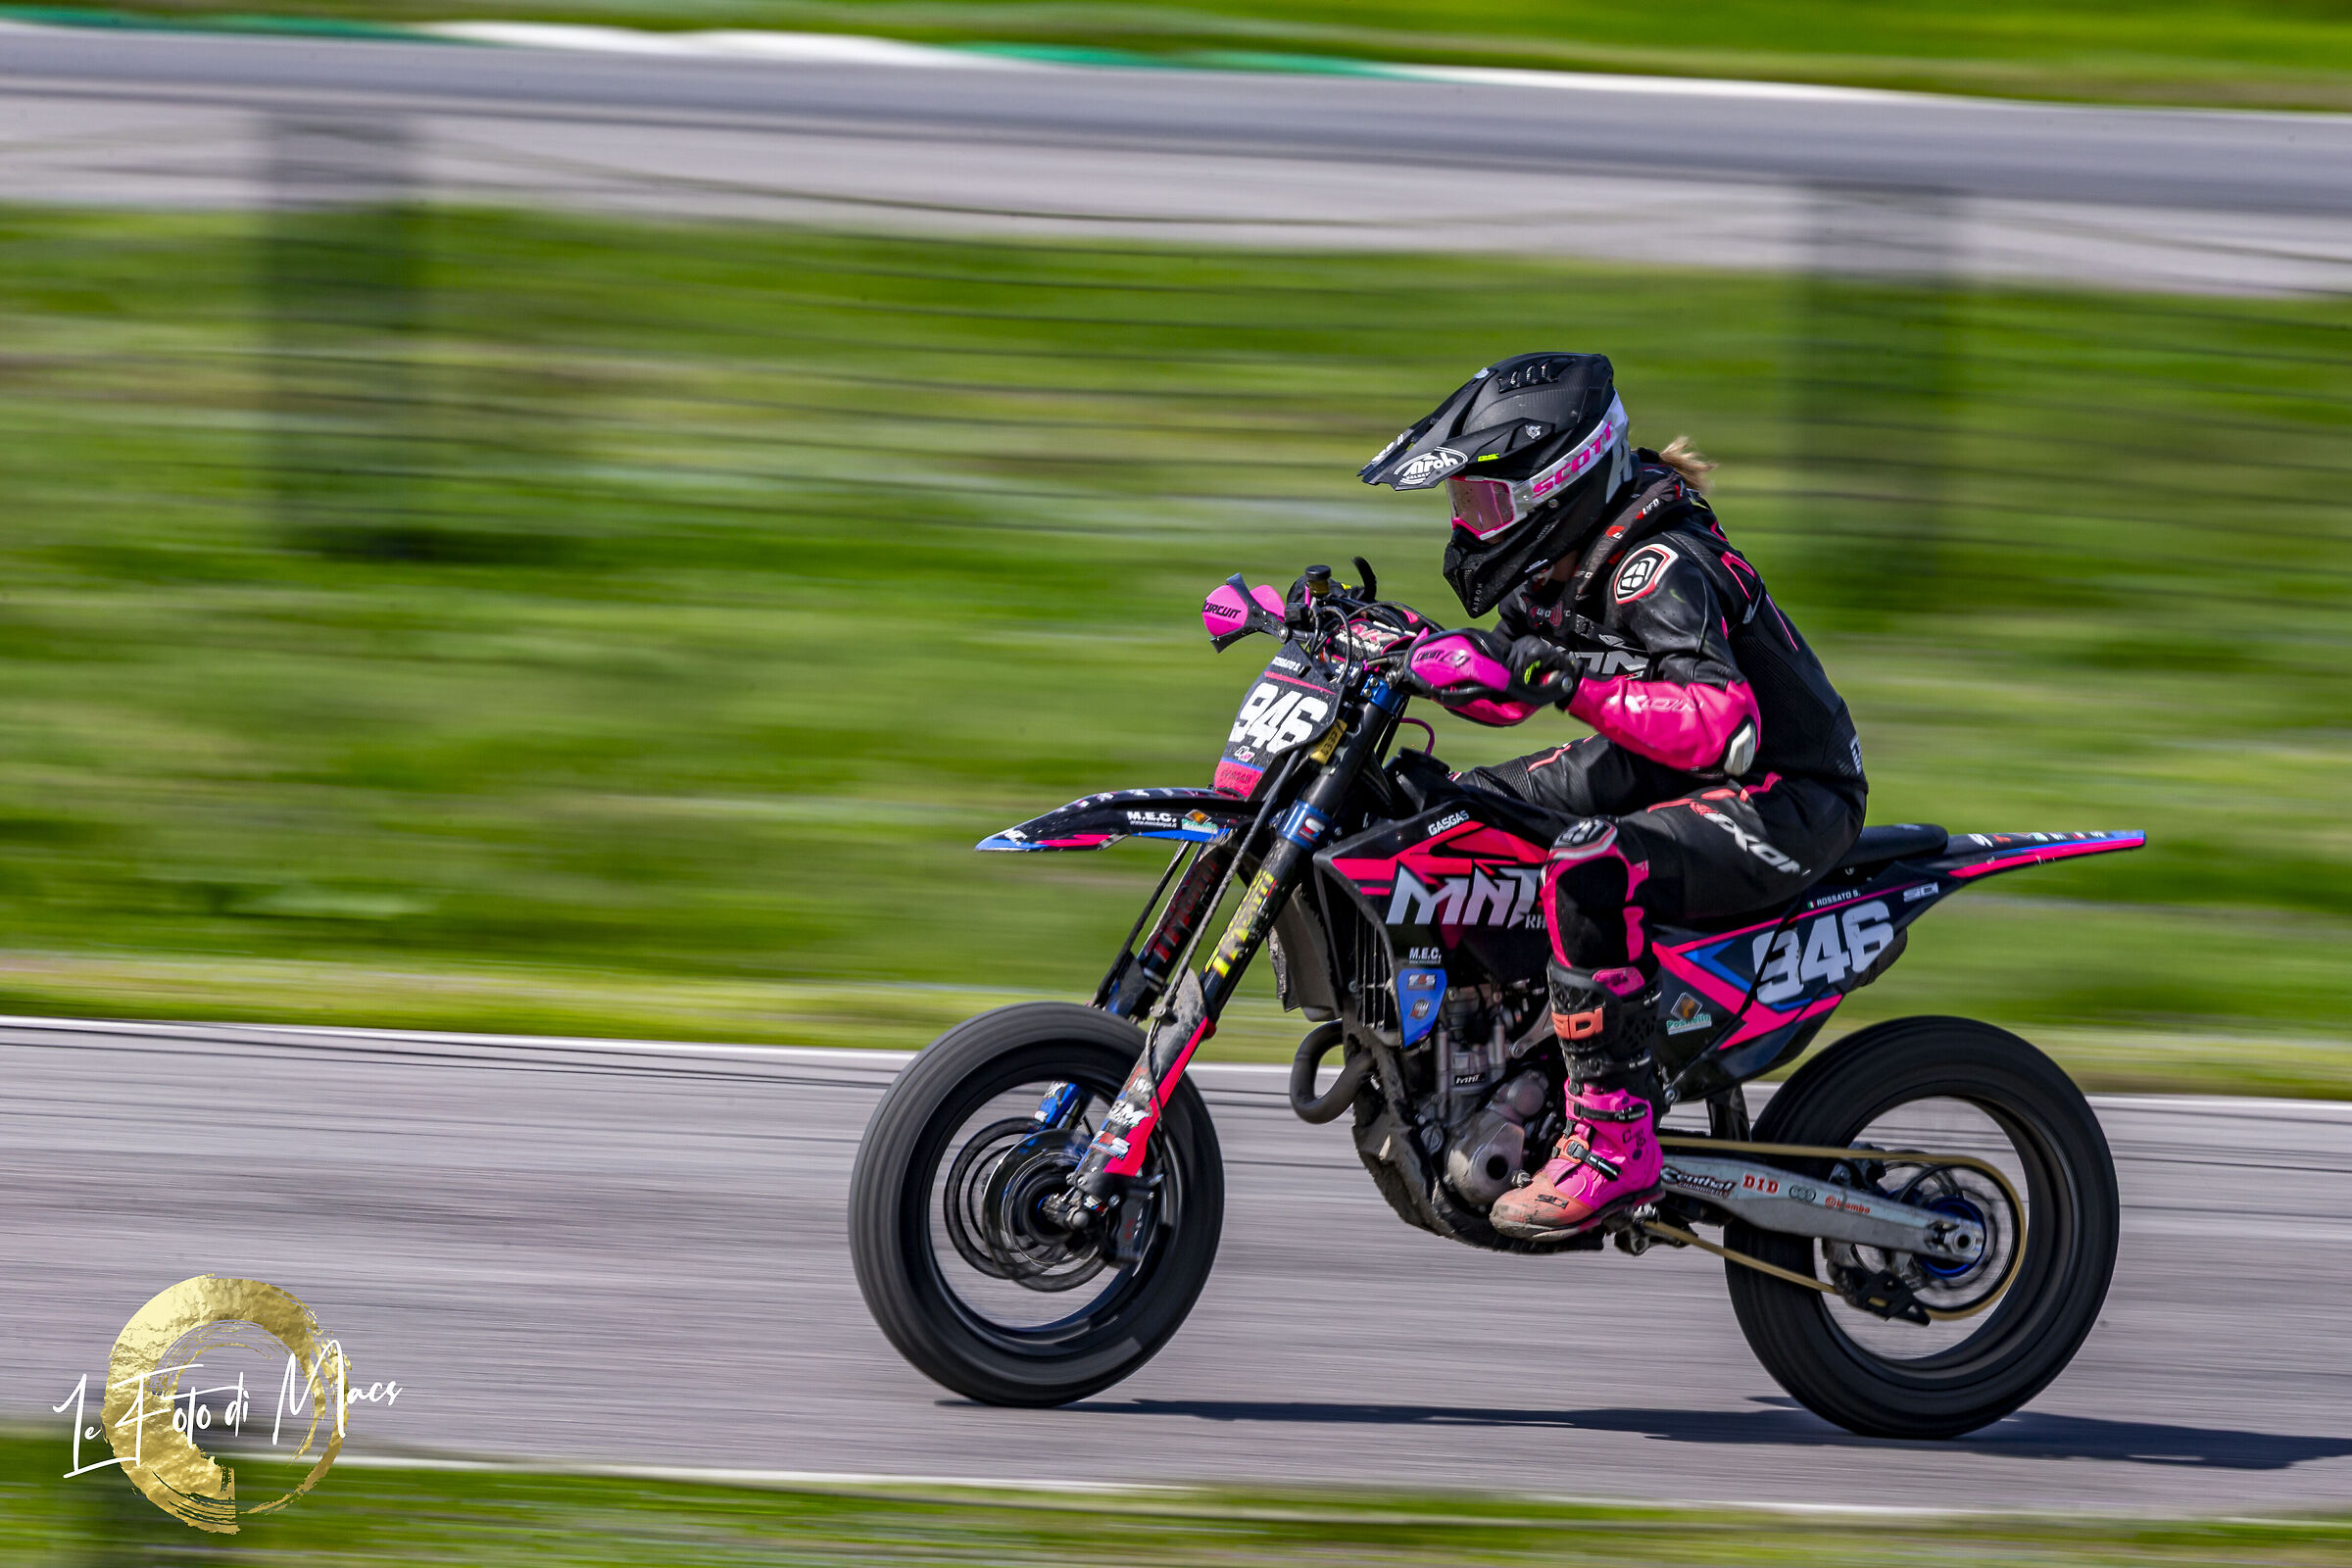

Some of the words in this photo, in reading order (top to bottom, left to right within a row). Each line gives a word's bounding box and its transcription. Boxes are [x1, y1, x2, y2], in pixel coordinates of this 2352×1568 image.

[1532, 420, 1612, 499] SCOTT
[1228, 682, 1329, 754] 946
[1126, 810, 1177, 822] M.E.C.
[1428, 809, 1470, 836] GASGAS
[1385, 864, 1540, 929] MNT
[1816, 891, 1851, 907] ROSSATO
[1408, 947, 1443, 960] M.E.C.
[1752, 900, 1894, 1004] 946
